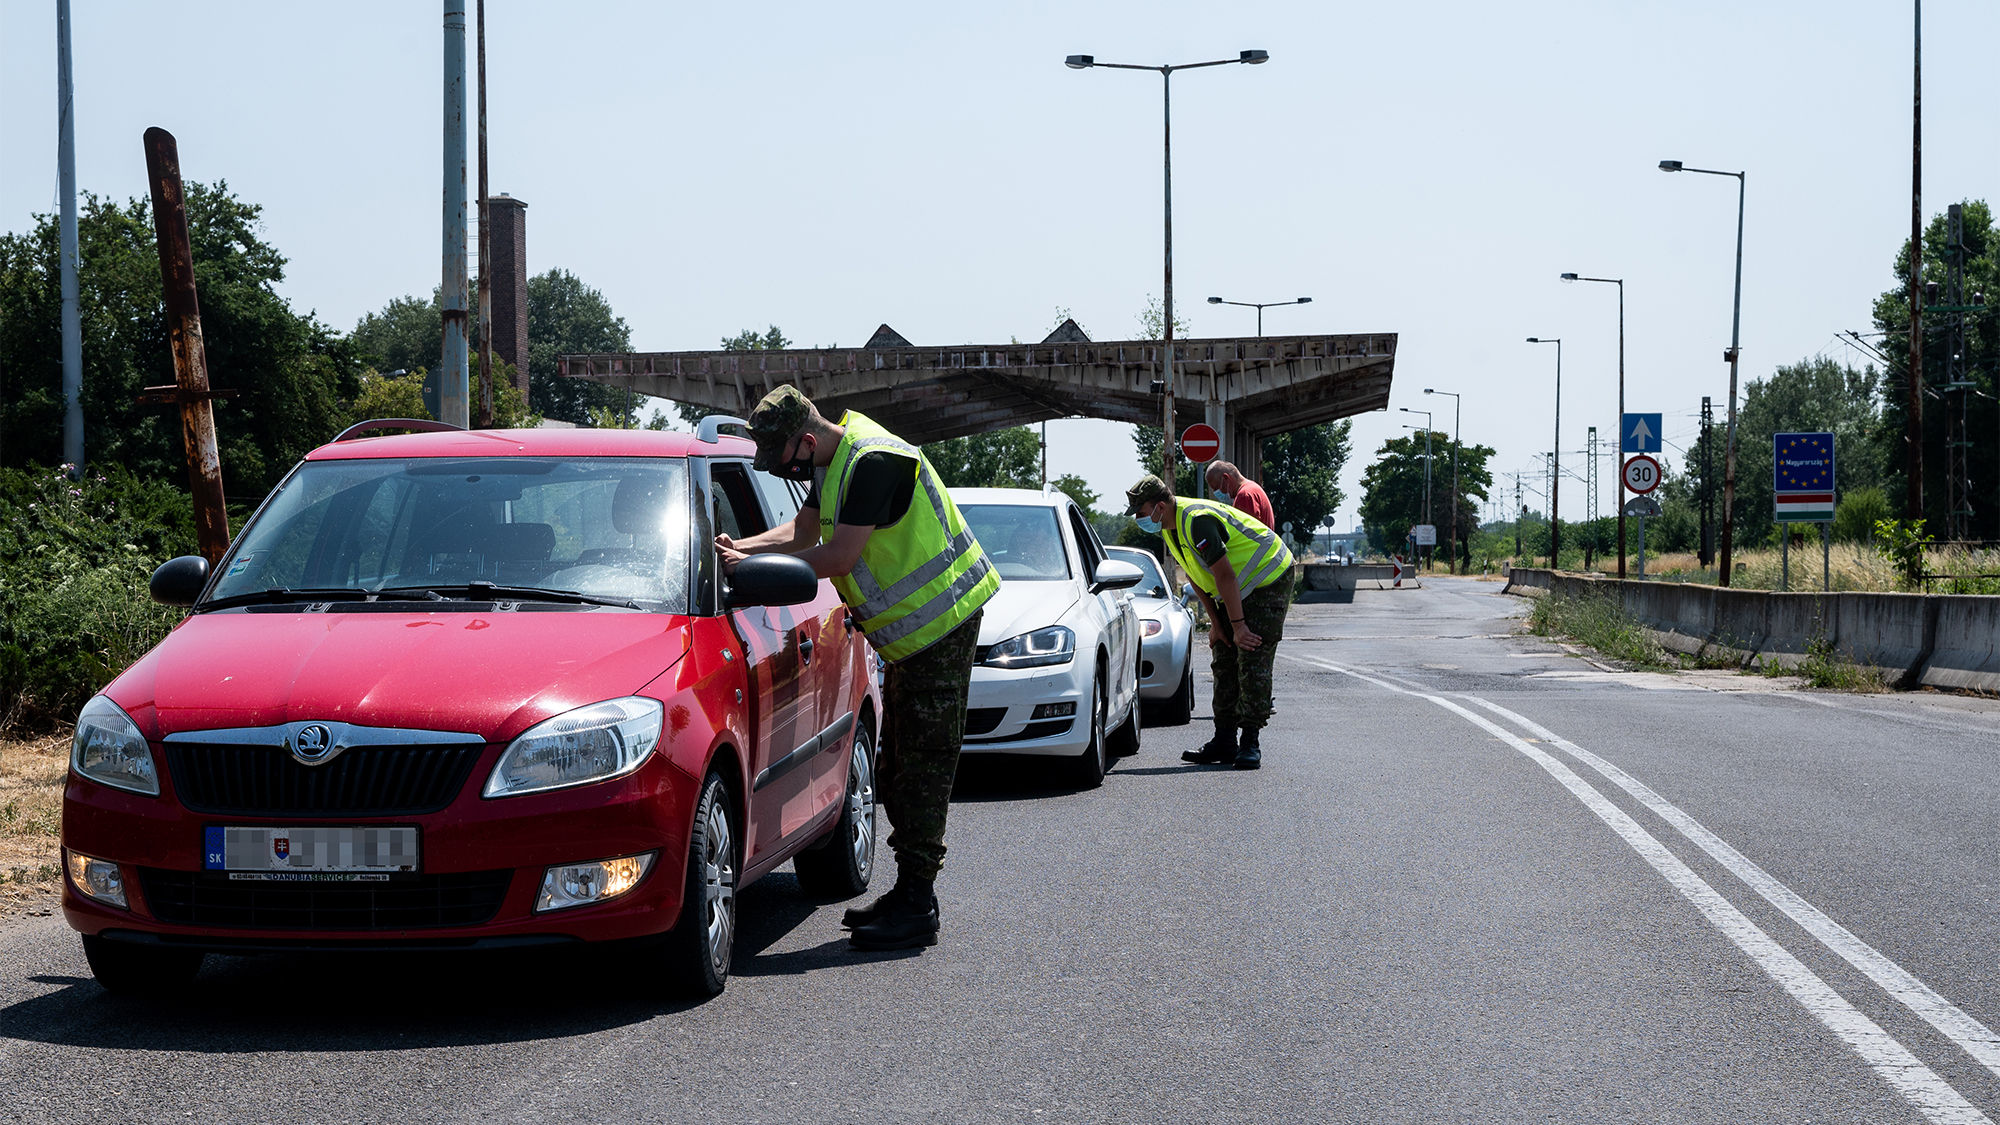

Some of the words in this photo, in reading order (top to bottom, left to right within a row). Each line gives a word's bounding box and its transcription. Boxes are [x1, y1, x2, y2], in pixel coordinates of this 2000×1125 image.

[1785, 459, 1823, 467] Magyarország
[1632, 467, 1651, 482] 30
[209, 853, 222, 863] SK
